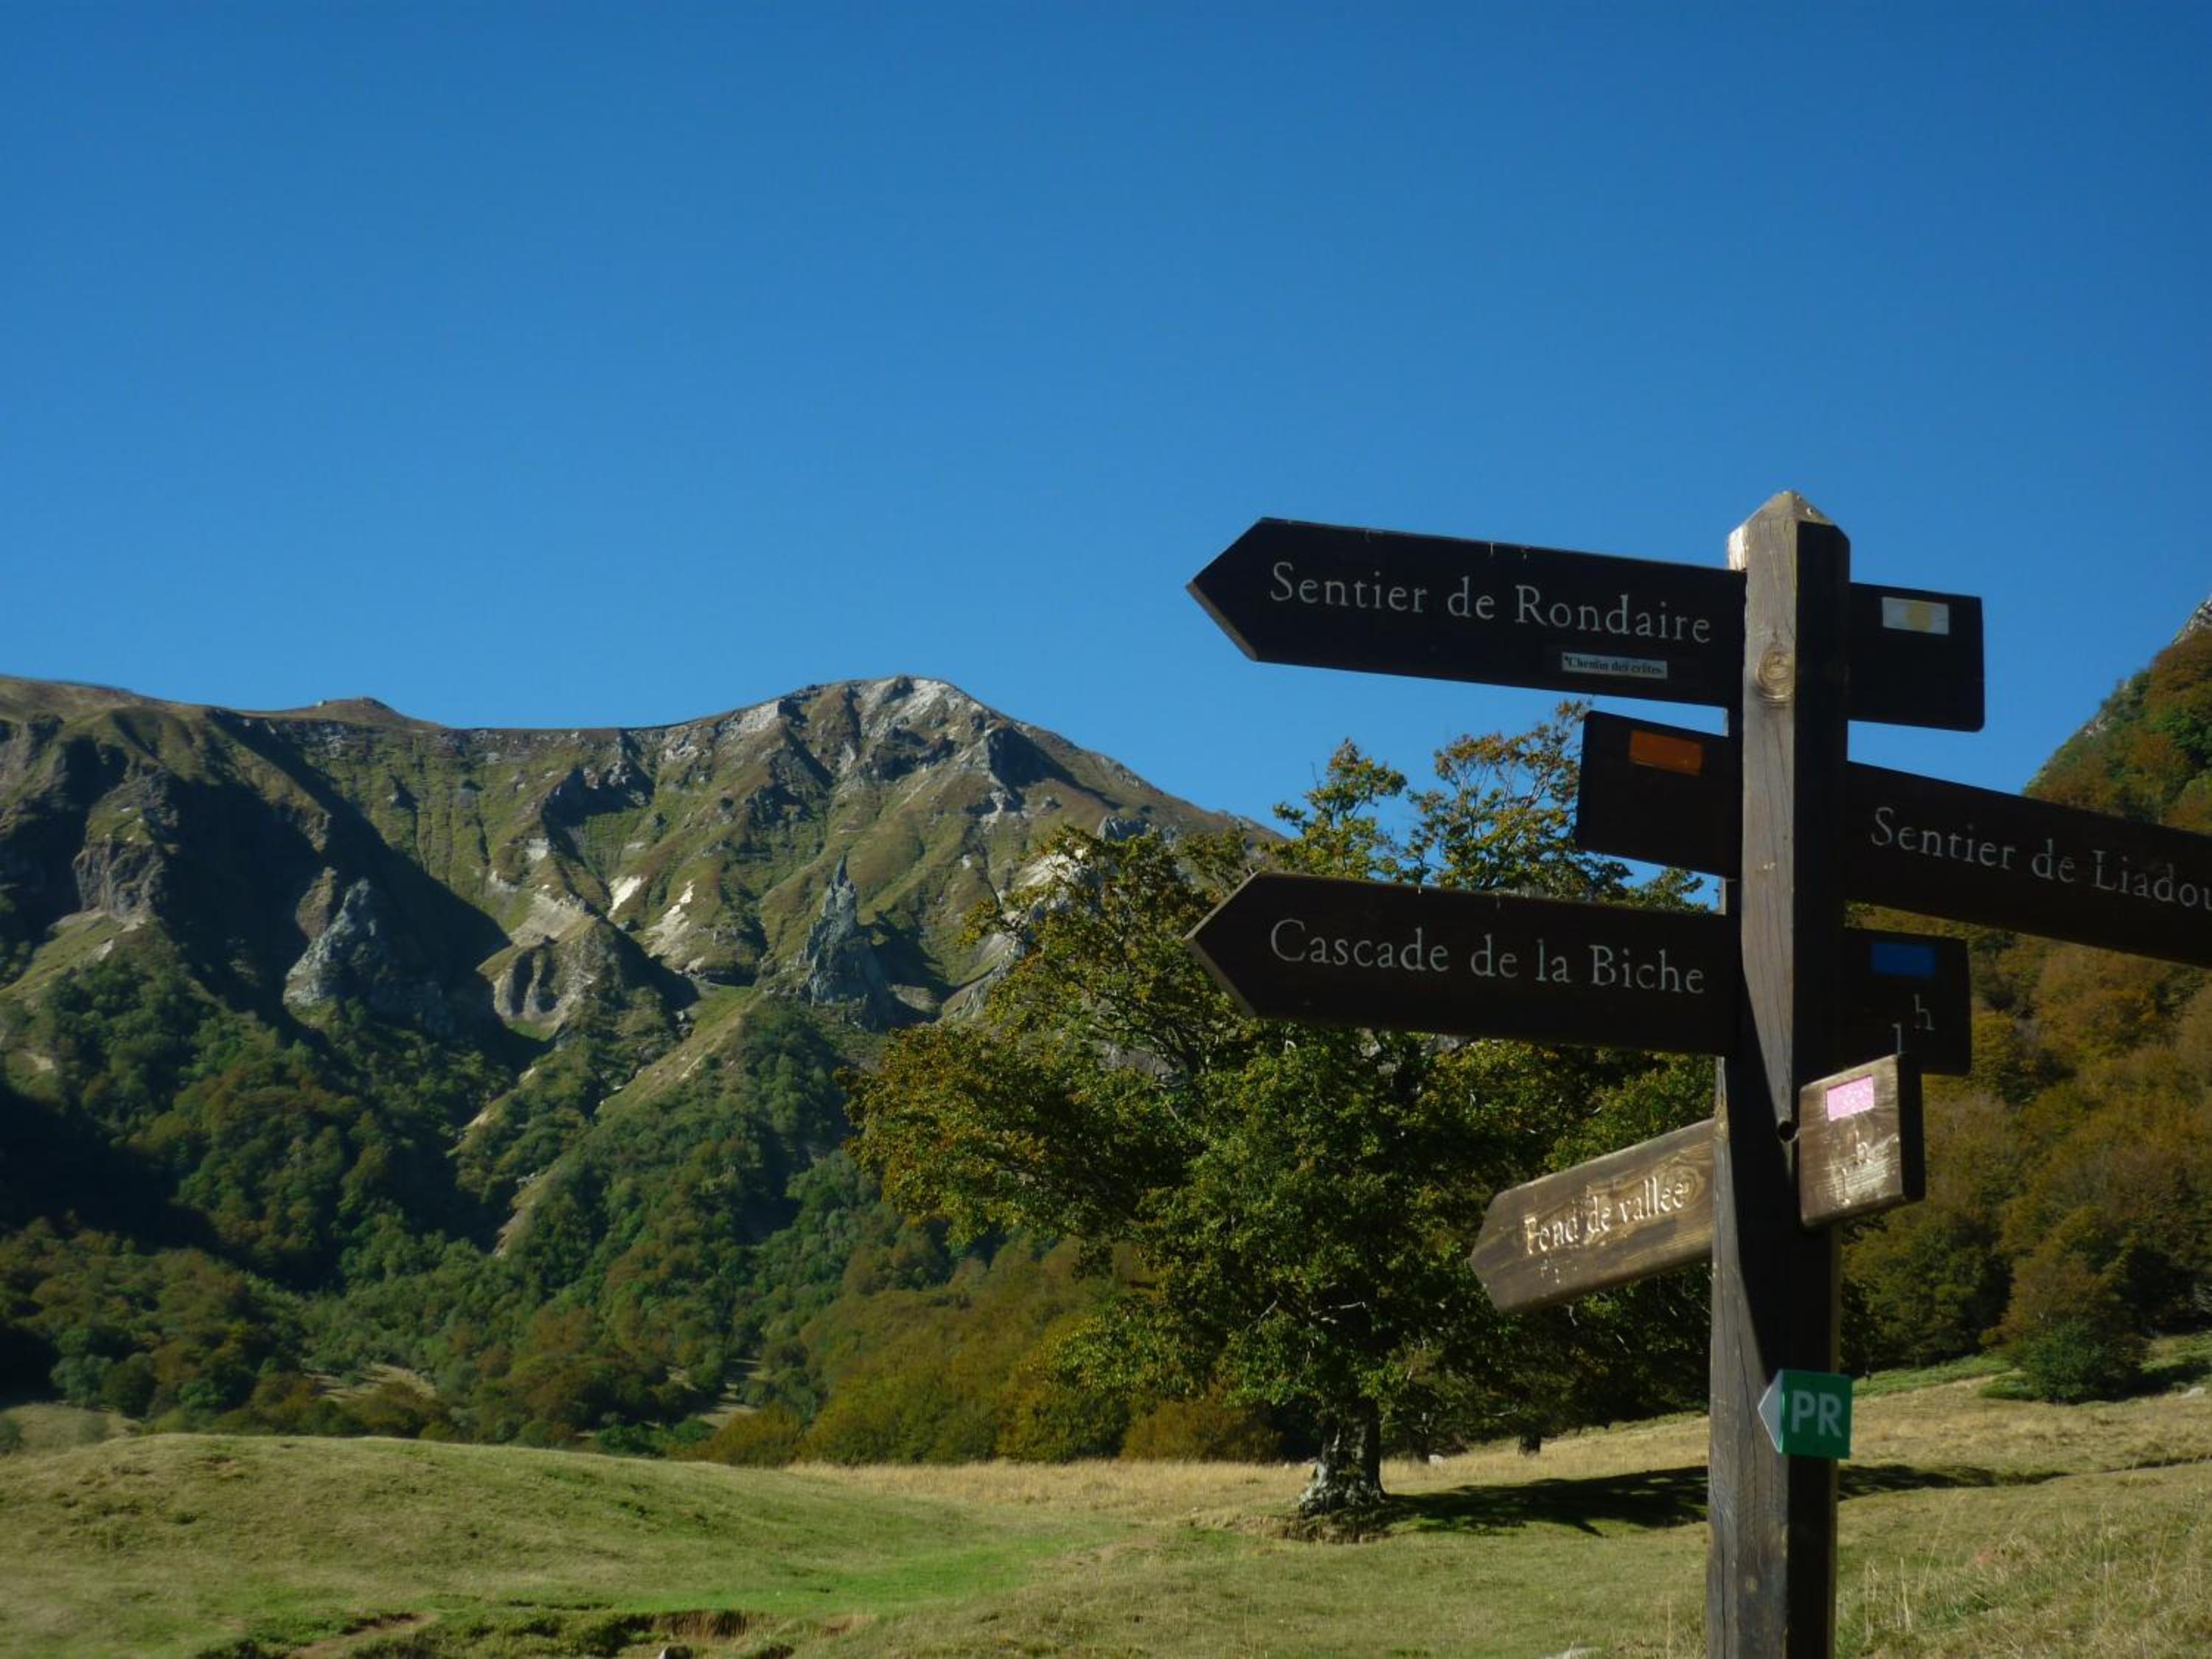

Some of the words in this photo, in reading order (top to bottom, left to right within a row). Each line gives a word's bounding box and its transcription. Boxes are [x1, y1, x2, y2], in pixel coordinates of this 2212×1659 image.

[1269, 561, 1429, 614] Sentier
[1446, 575, 1496, 620] de
[1514, 584, 1712, 644] Rondaire
[1870, 806, 2017, 871] Sentier
[2031, 838, 2078, 884] de
[1270, 917, 1450, 973] Cascade
[1470, 933, 1520, 980] de
[1536, 938, 1571, 985] la
[1588, 943, 1705, 995] Biche
[1585, 1194, 1613, 1234] de
[1791, 1389, 1843, 1439] PR
